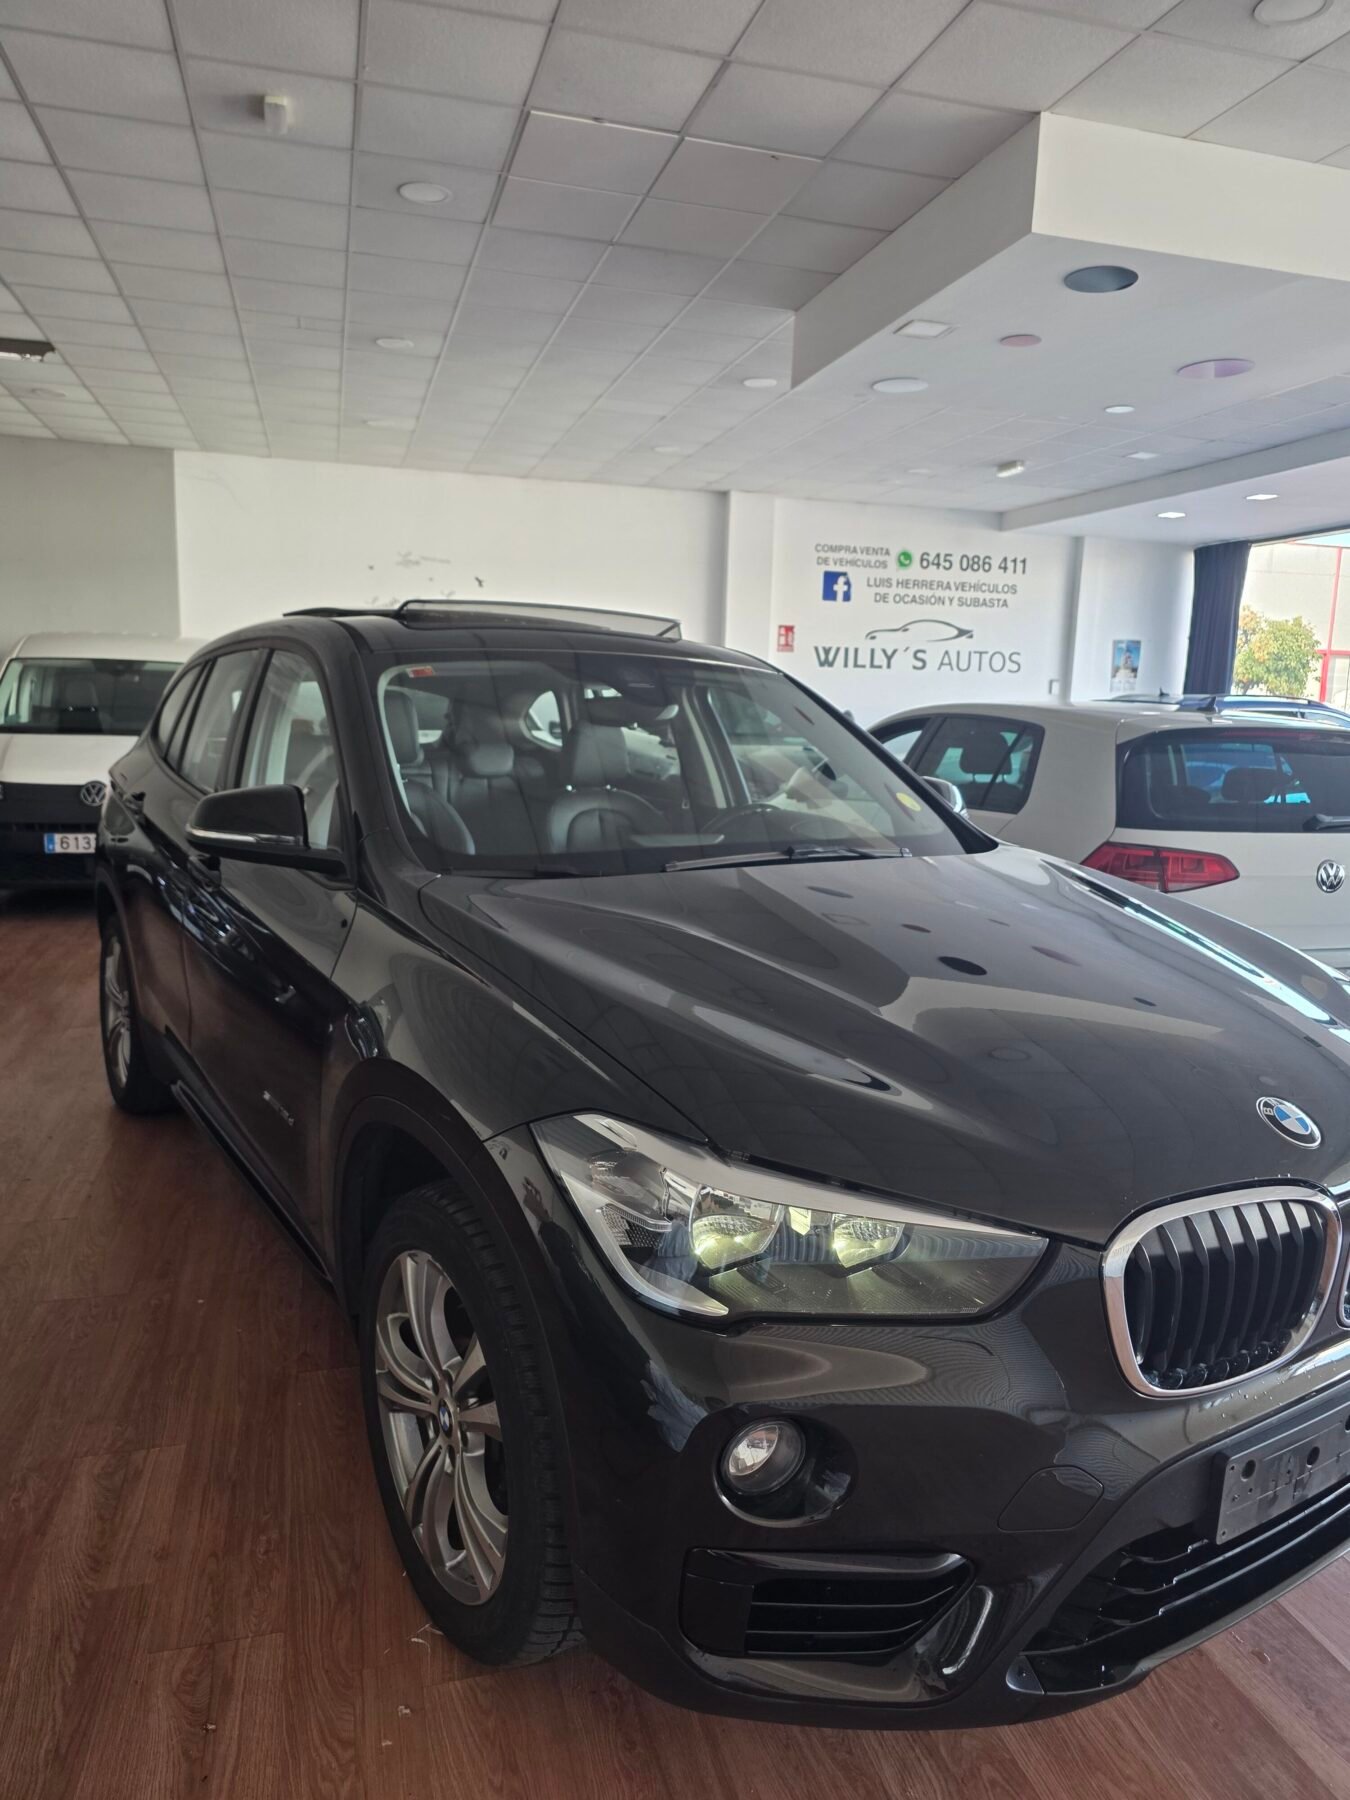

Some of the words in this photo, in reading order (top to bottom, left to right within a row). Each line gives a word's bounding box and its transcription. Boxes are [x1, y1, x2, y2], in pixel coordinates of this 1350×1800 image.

[814, 543, 858, 554] COMPRA
[858, 546, 891, 557] VENTA
[816, 556, 830, 566] DE
[919, 552, 953, 571] 645
[959, 554, 992, 573] 086
[998, 556, 1027, 575] 411
[866, 577, 893, 589] LUIS
[896, 578, 952, 592] HERRERA
[953, 580, 1018, 595] VEHÍCULOS
[874, 592, 890, 604] DE
[892, 592, 945, 606] OCASIÓN
[947, 596, 955, 606] Y
[957, 596, 1009, 609] SUBASTA
[937, 650, 1022, 673] AUTOS
[60, 836, 96, 850] 613
